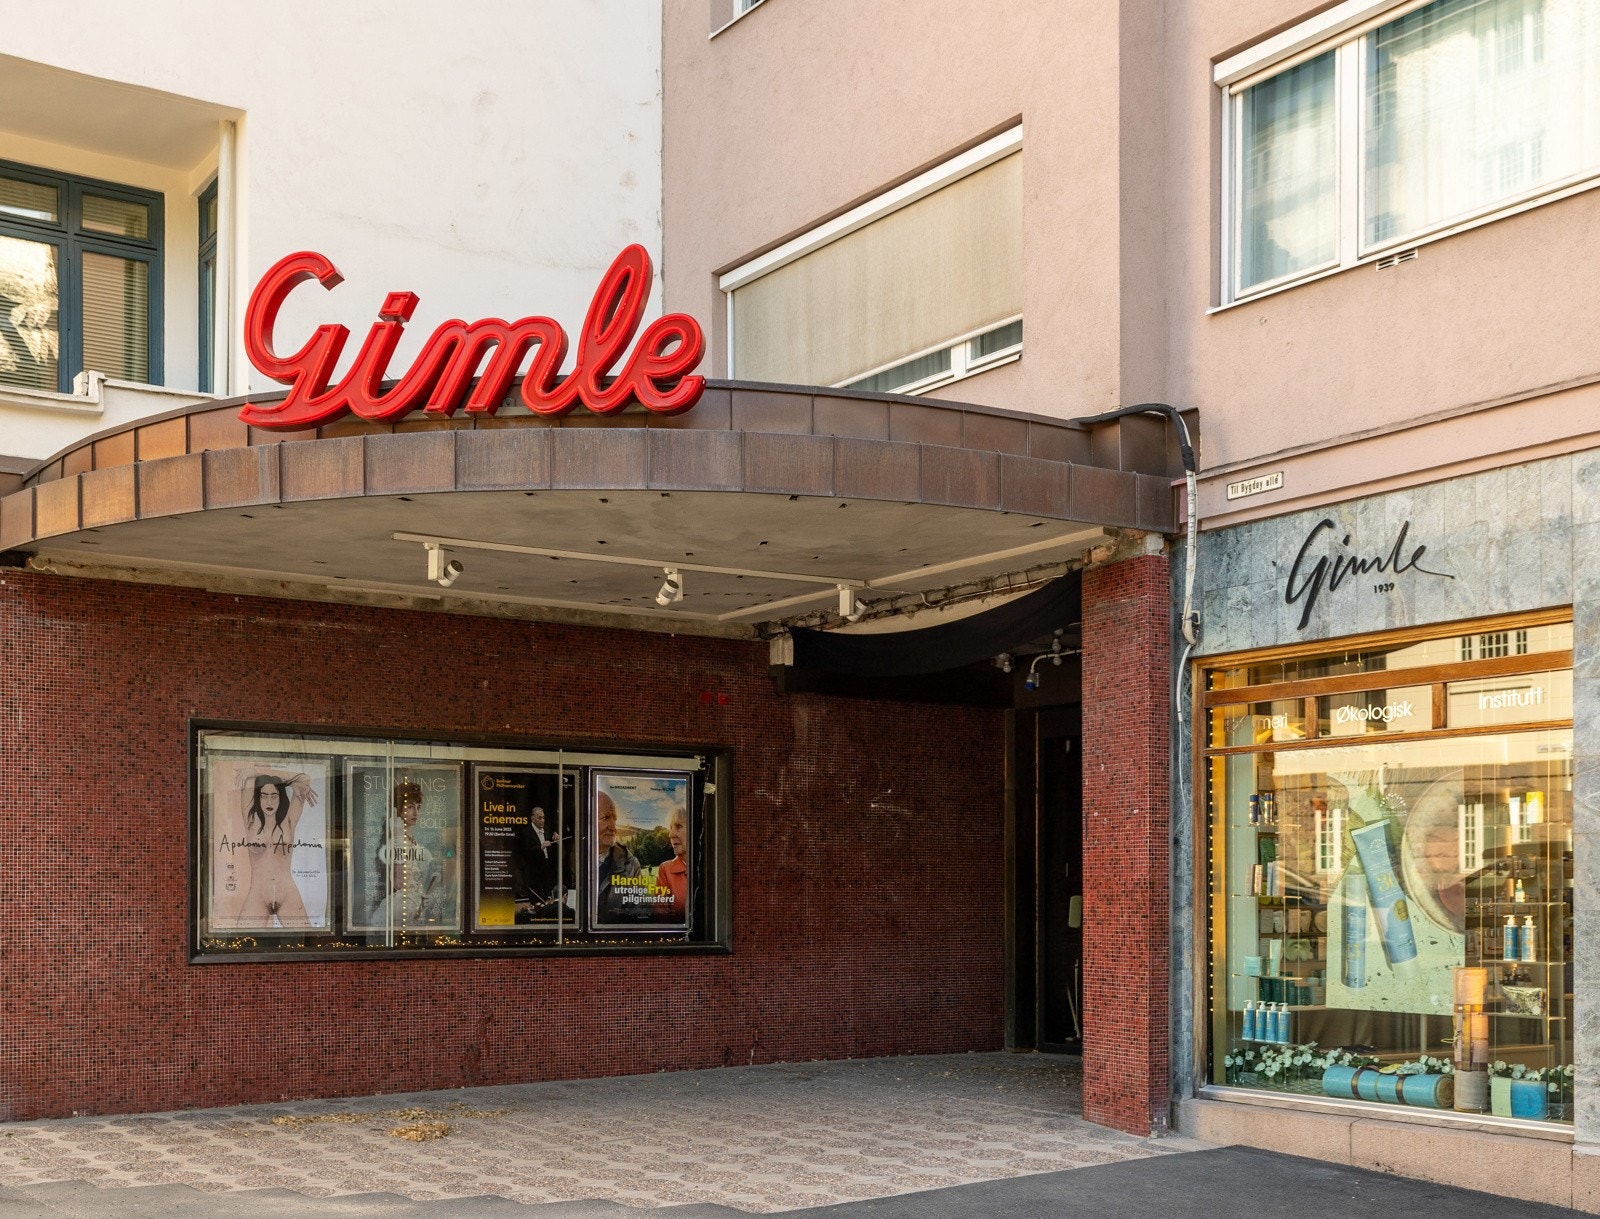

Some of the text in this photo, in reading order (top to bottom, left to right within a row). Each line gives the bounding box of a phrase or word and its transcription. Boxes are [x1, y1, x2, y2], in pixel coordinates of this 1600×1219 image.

[238, 243, 706, 431] Gimle
[1230, 485, 1239, 495] Til
[1265, 474, 1279, 487] allé
[1285, 519, 1455, 630] Gimle
[1373, 582, 1395, 594] 1939
[1478, 687, 1543, 710] Institutt
[1336, 700, 1414, 724] Økologisk
[483, 801, 516, 812] Live in
[483, 814, 528, 825] cinemas
[611, 875, 649, 886] Harold
[614, 886, 648, 896] utrolige
[622, 895, 675, 905] pilgrimsferd
